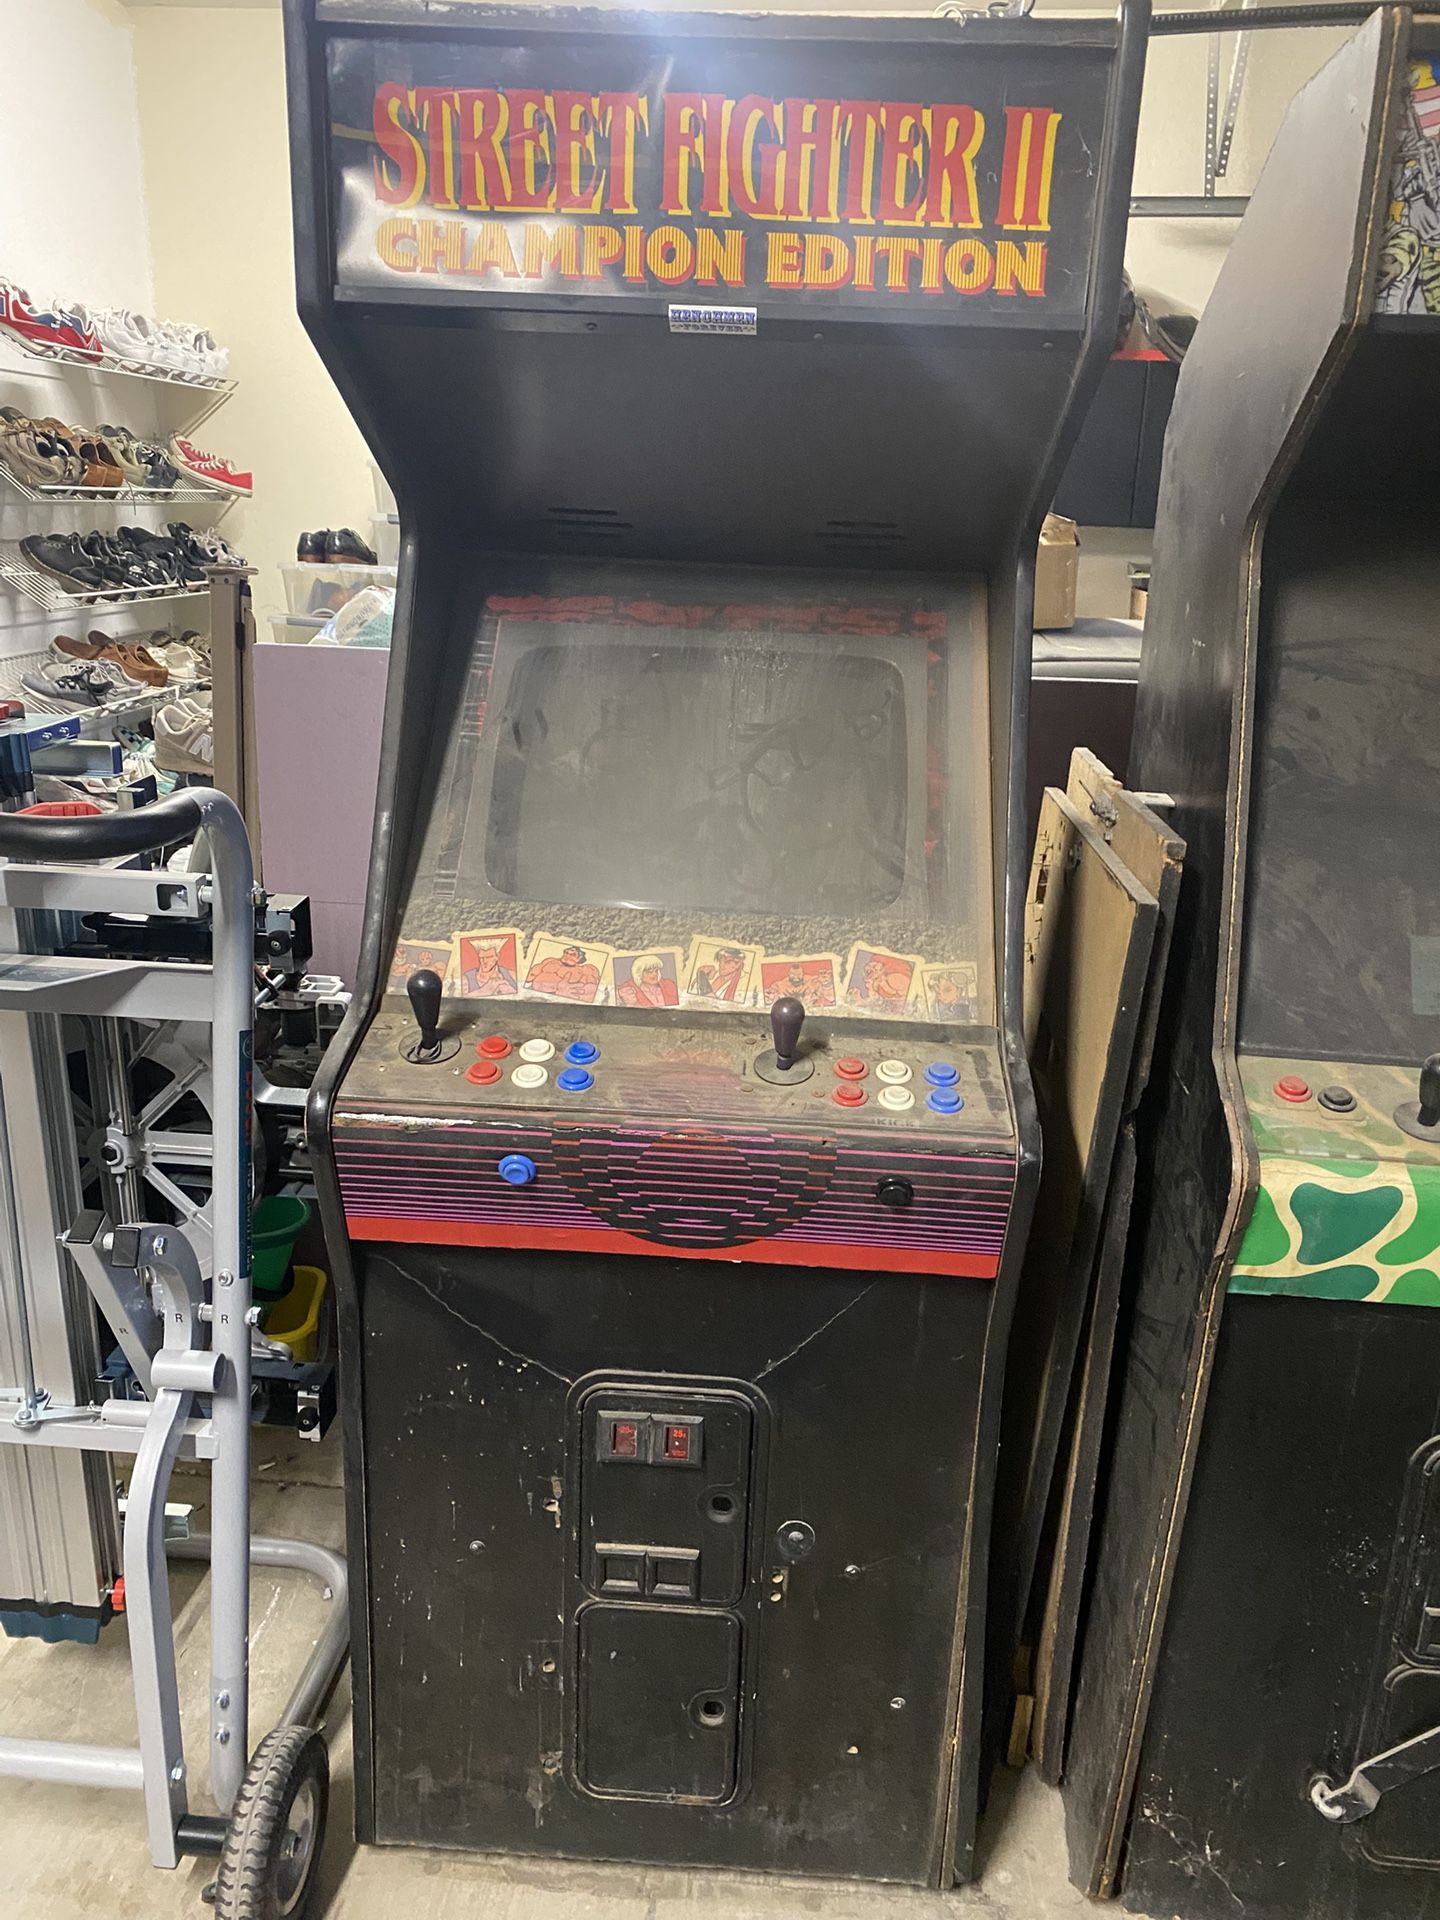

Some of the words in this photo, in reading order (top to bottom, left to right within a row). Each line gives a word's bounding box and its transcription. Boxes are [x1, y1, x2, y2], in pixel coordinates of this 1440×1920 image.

[373, 82, 649, 214] STREET
[659, 92, 985, 229] FIGHTER
[995, 106, 1063, 231] II
[375, 218, 746, 288] CHAMPION
[764, 231, 1049, 297] EDITION
[175, 1313, 184, 1323] R
[221, 1314, 229, 1324] R
